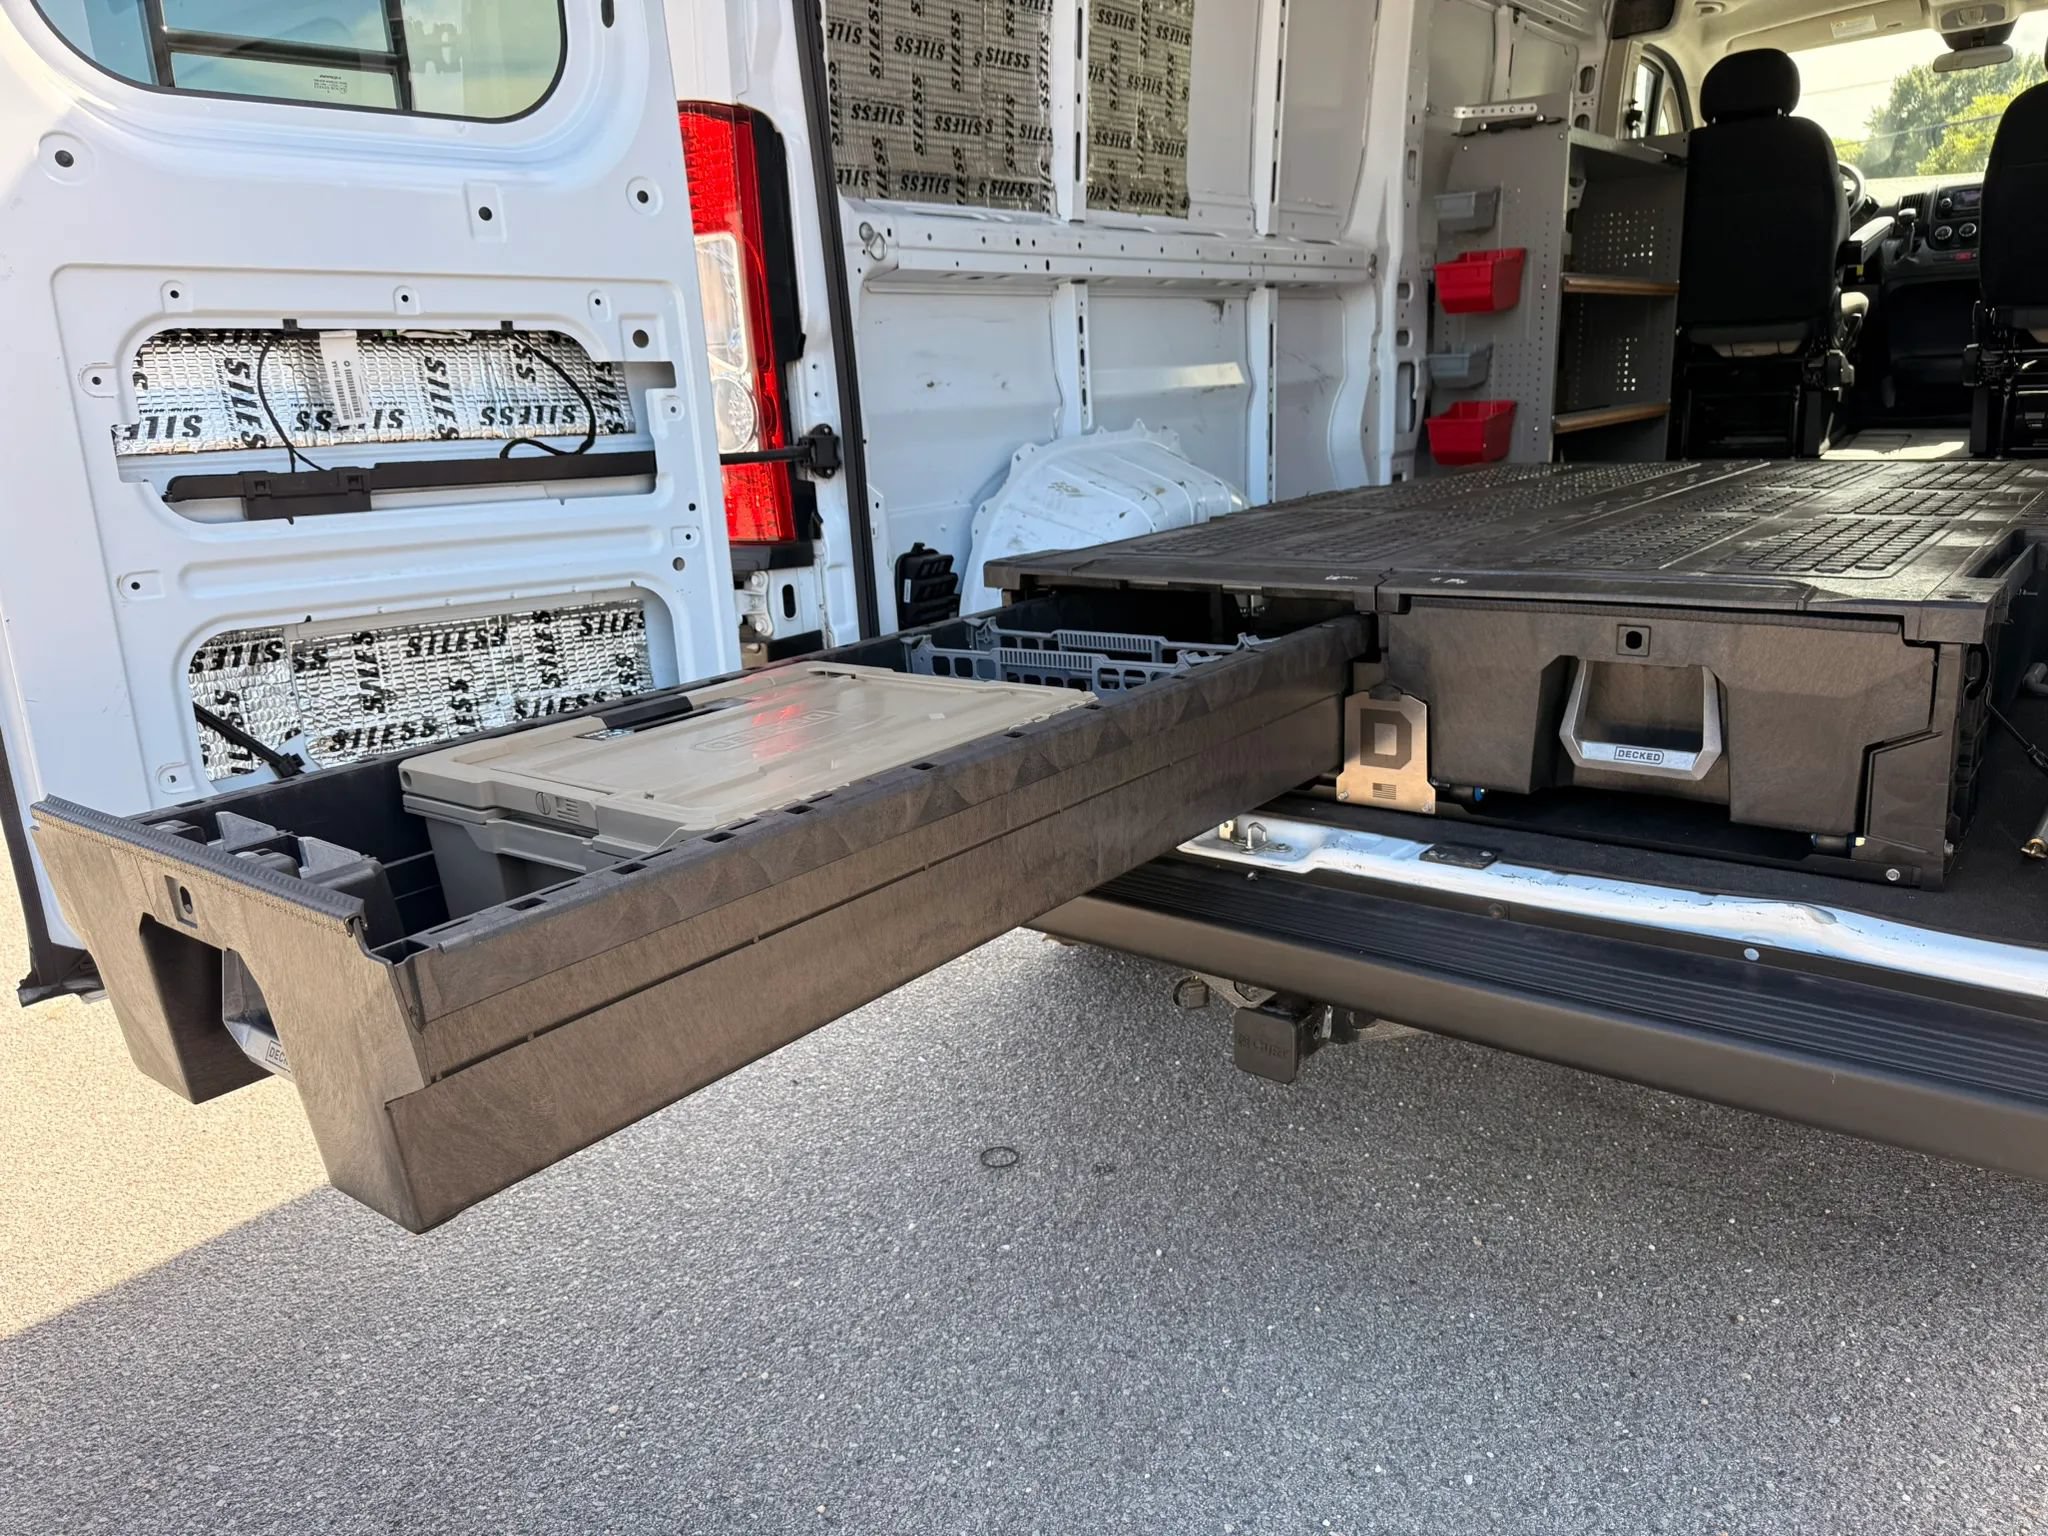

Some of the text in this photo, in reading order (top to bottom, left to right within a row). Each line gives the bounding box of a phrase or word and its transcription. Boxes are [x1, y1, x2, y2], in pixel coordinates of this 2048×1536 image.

[1097, 9, 1136, 31] SILESS
[1156, 24, 1191, 46] SILESS
[894, 36, 945, 60] SILESS
[951, 8, 961, 93] SILESS
[986, 46, 1031, 69] SILESS
[1127, 74, 1163, 95] SILESS
[851, 103, 905, 125] SILESS
[911, 72, 925, 156] SILESS
[933, 115, 982, 136] SILESS
[1094, 131, 1133, 149] SILESS
[1152, 140, 1186, 158] SILESS
[900, 175, 950, 194] SILESS
[990, 181, 1034, 198] SILESS
[480, 405, 577, 426] SILESS
[406, 627, 507, 658] SILESS
[329, 719, 437, 752] SILESS
[1617, 749, 1661, 761] DECKED
